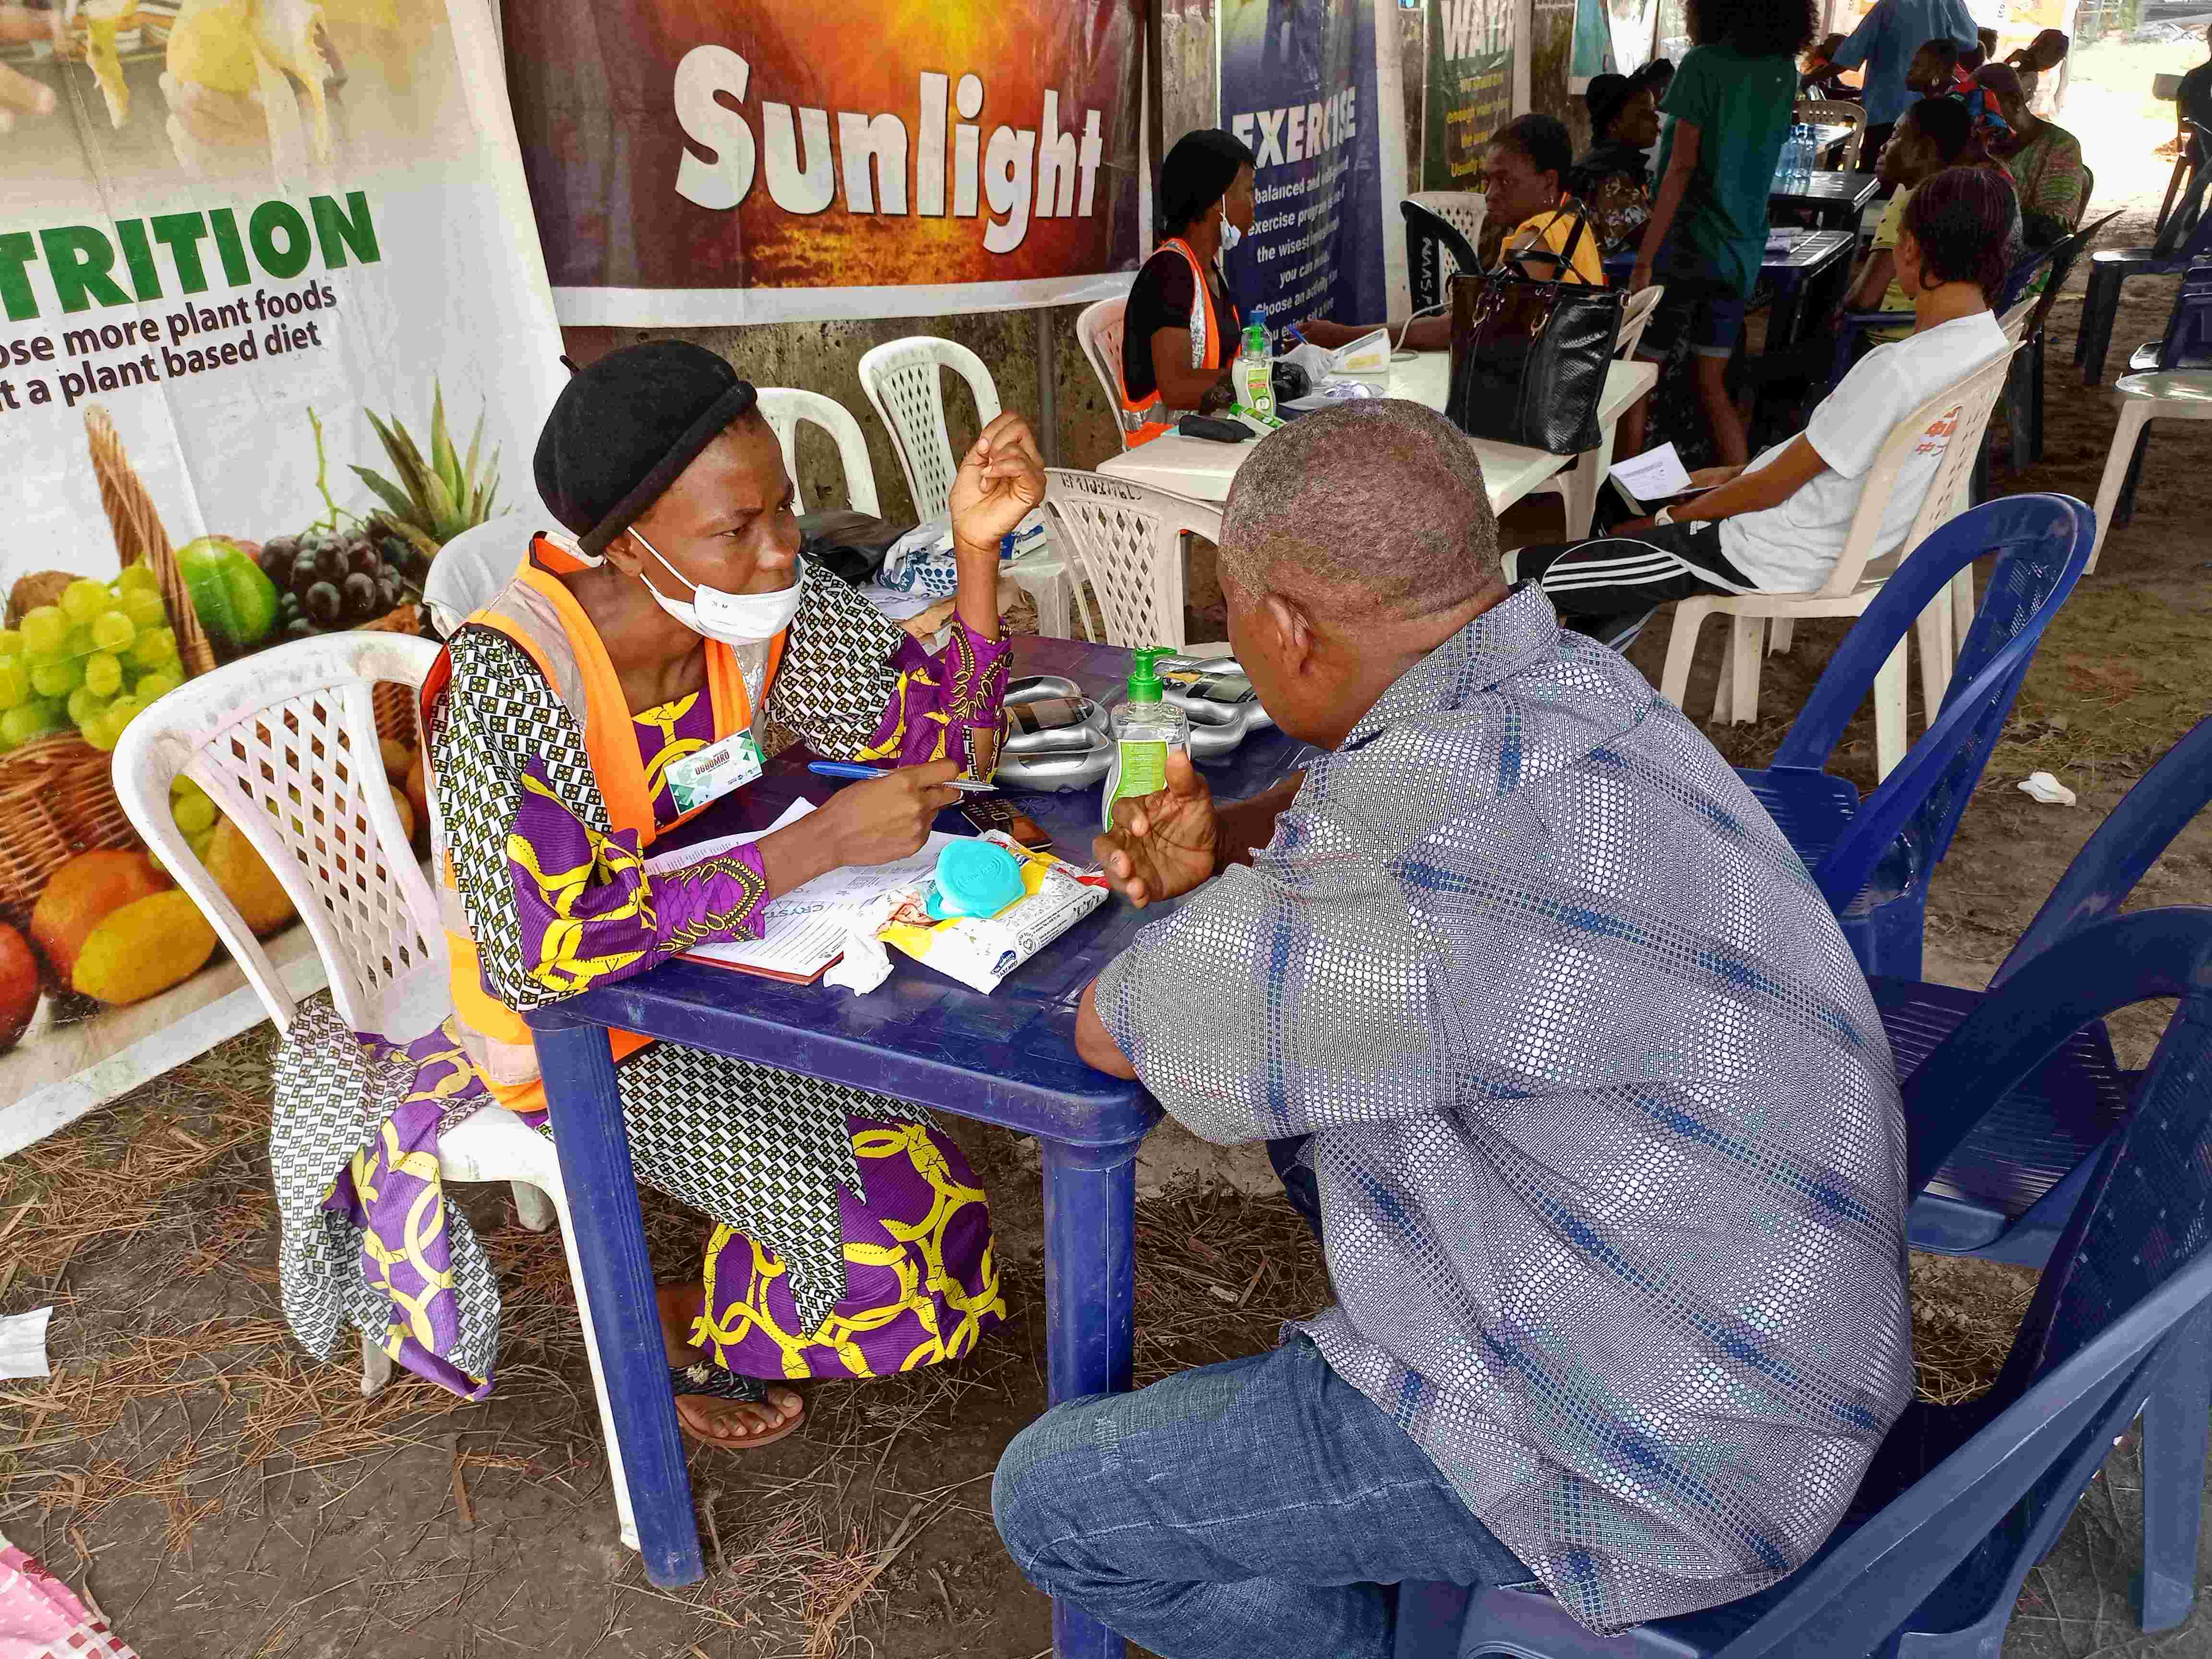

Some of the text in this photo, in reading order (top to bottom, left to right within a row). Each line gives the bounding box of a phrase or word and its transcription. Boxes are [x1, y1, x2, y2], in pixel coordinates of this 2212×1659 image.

[673, 43, 1103, 254] Sunlight
[1232, 86, 1357, 169] EXERCISE
[1254, 177, 1305, 204] balanced
[1248, 212, 1296, 237] exercise
[1257, 245, 1275, 263] the
[1278, 233, 1310, 257] wisest
[0, 191, 381, 322] TRITION
[1280, 267, 1297, 289] you
[1299, 261, 1313, 277] can
[62, 317, 160, 357] more
[166, 297, 252, 346] plant
[254, 279, 337, 321] foods
[1295, 291, 1305, 306] an
[0, 320, 322, 411] t a plant based diet
